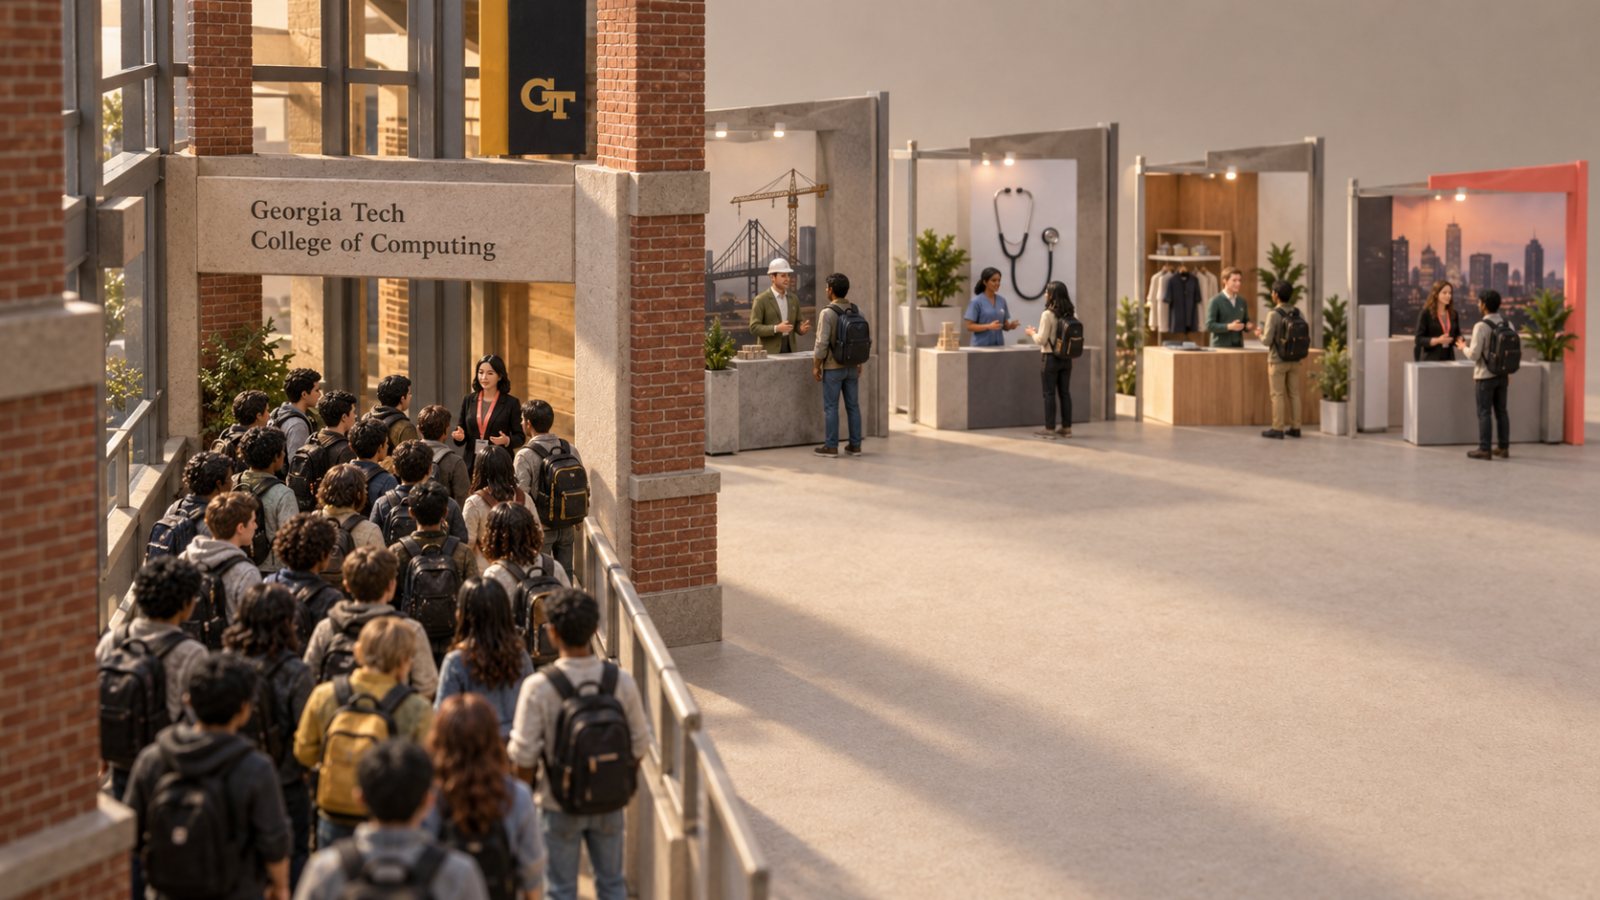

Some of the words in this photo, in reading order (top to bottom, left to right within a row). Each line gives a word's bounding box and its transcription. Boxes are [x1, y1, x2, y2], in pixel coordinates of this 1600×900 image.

[520, 77, 576, 120] GT
[250, 199, 343, 227] Georgia
[350, 202, 406, 223] Tech
[250, 230, 332, 257] College
[340, 232, 364, 253] of
[370, 233, 497, 262] Computing
